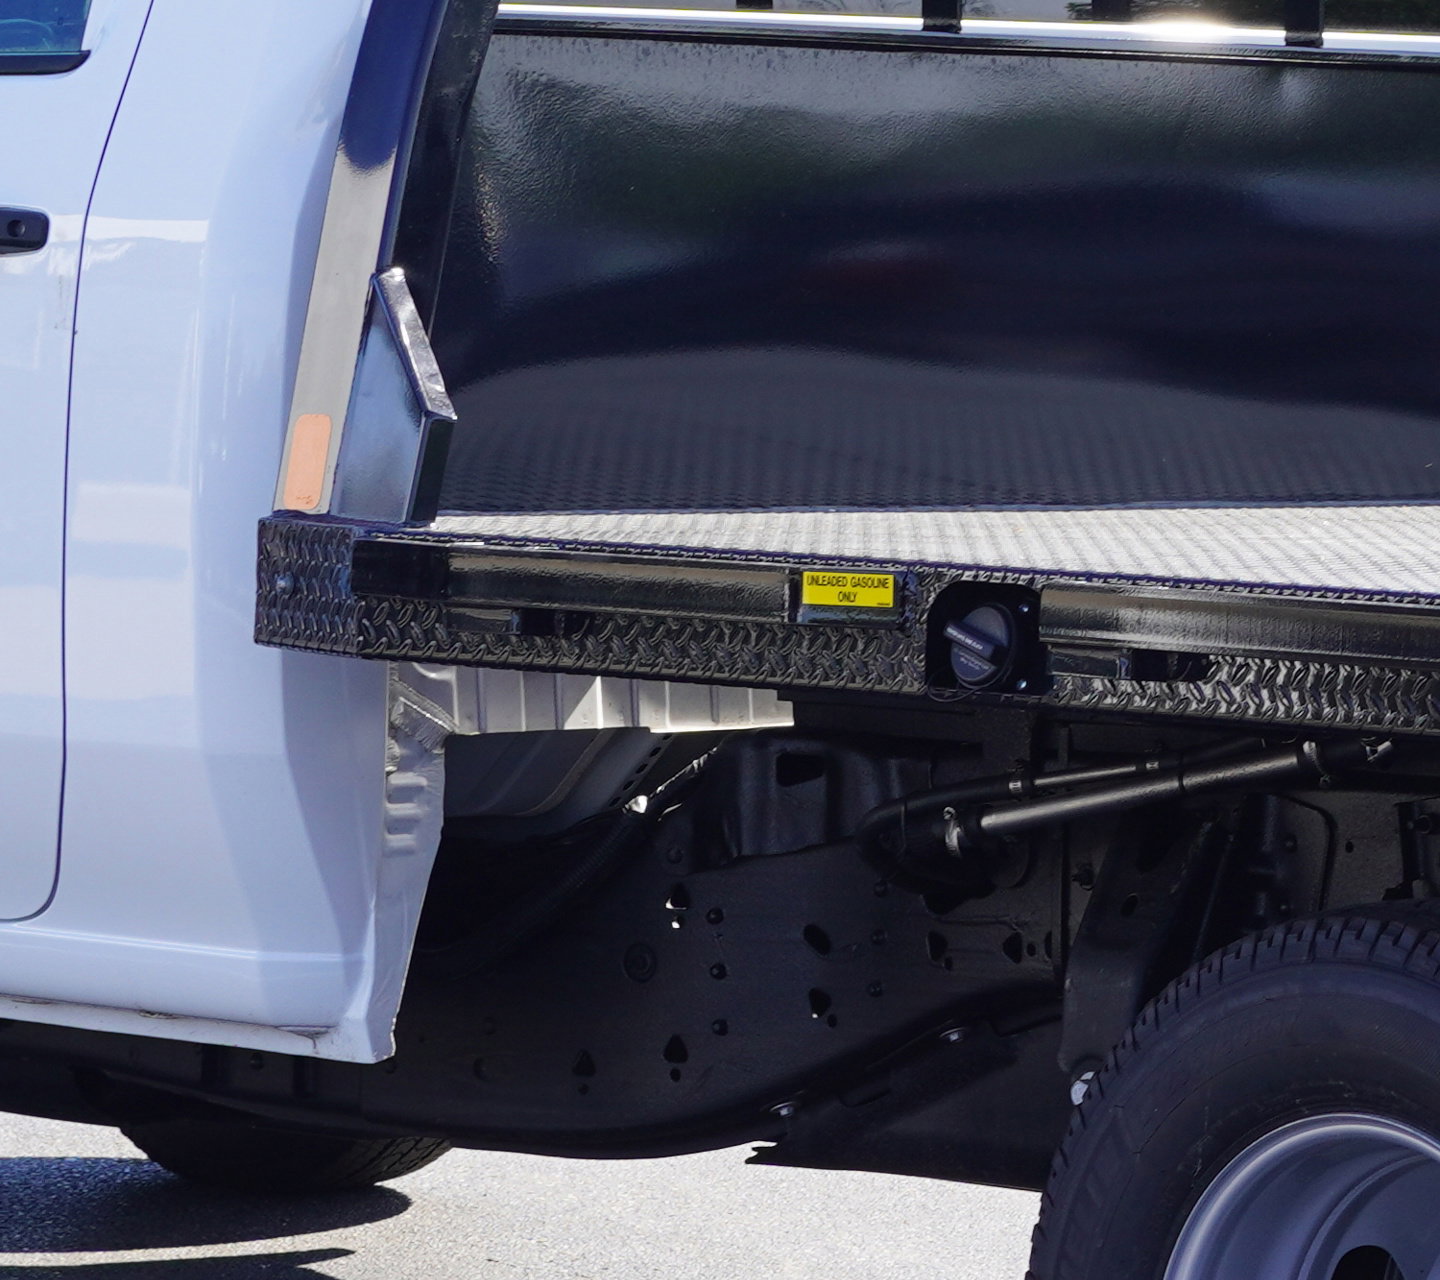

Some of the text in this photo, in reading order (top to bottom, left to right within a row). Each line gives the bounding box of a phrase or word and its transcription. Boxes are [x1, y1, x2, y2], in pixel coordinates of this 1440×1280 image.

[806, 575, 890, 589] UNLEADED GASOLINE
[837, 591, 858, 603] ONLY
